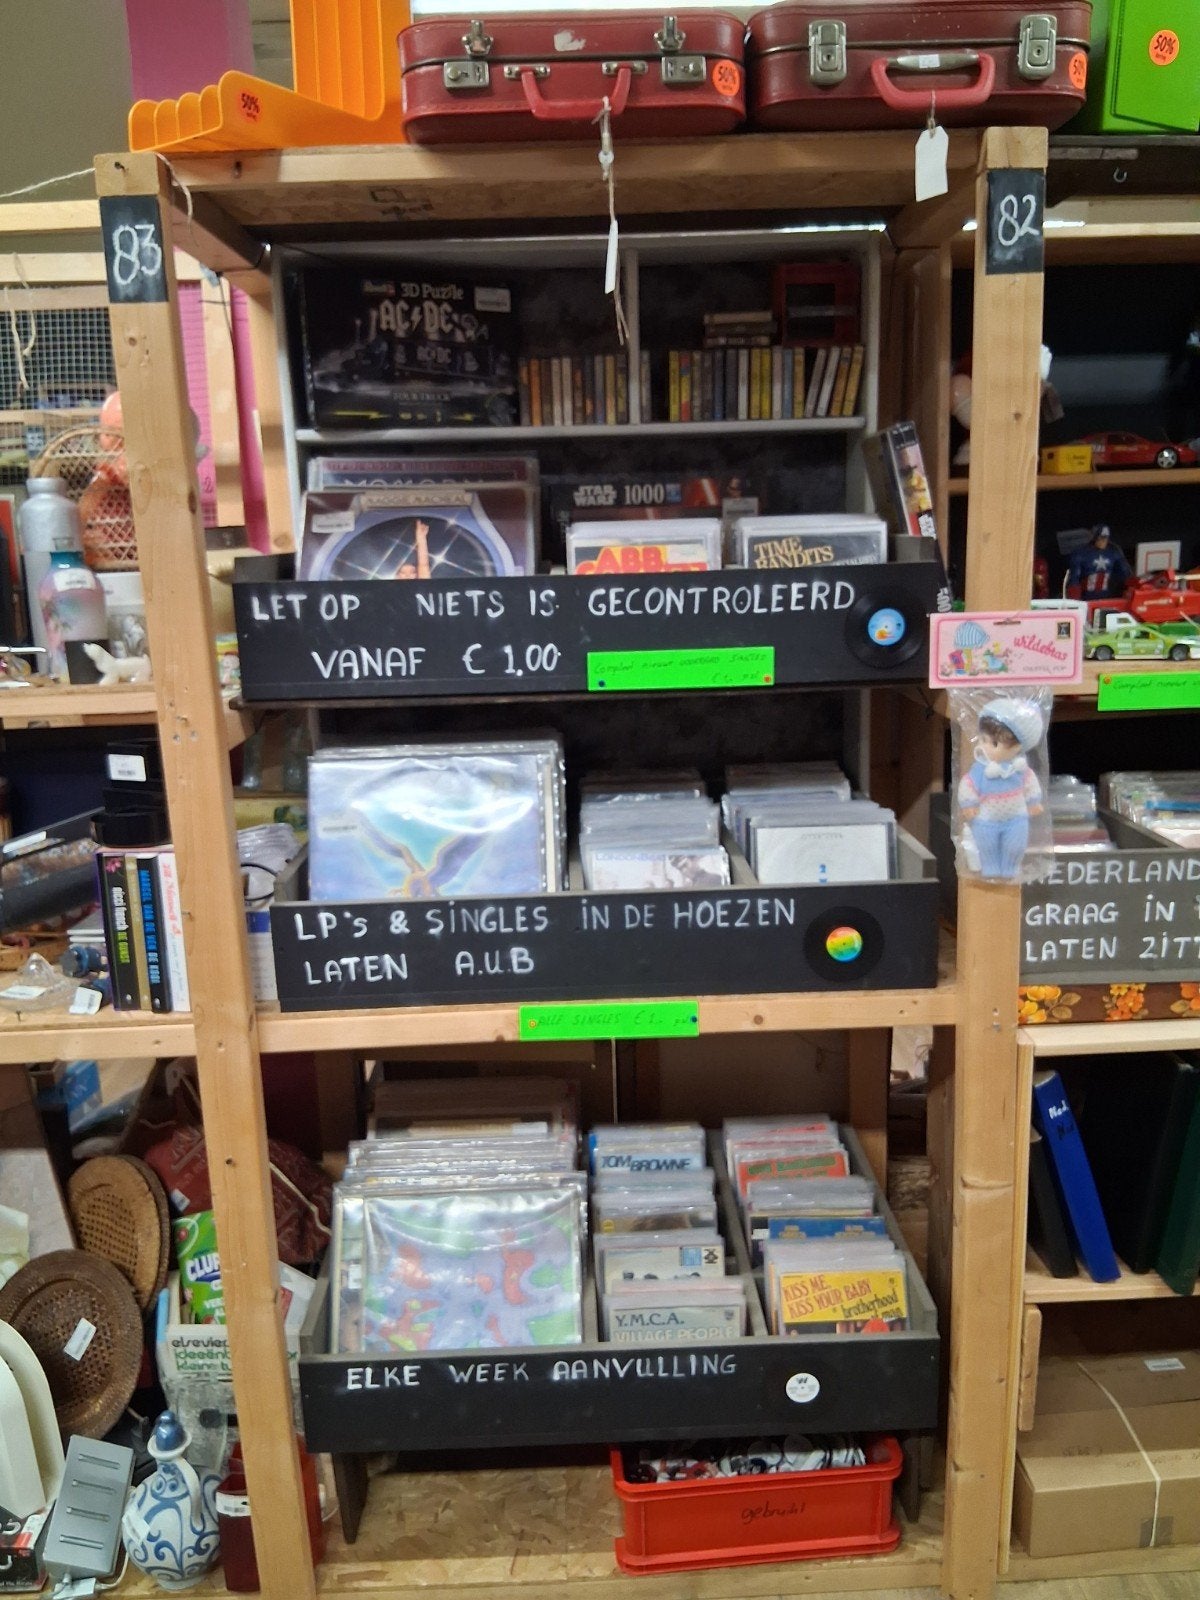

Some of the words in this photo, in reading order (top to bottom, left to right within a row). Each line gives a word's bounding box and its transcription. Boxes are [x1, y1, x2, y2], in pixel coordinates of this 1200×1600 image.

[1154, 34, 1176, 55] 50%
[998, 194, 1040, 246] 82
[112, 223, 163, 285] 83
[624, 483, 665, 505] 1000
[754, 537, 802, 559] TIME
[252, 594, 307, 621] LET
[319, 593, 360, 621] OP
[416, 590, 505, 618] NIETS
[529, 589, 557, 617] IS
[588, 580, 856, 617] GECONTROLEERD
[310, 646, 426, 680] VANAF
[462, 643, 486, 674] €
[503, 643, 560, 677] 1.00
[1026, 857, 1200, 886] EDERLAND
[294, 911, 368, 941] LP's
[389, 910, 410, 935] &
[624, 904, 656, 930] DE
[674, 898, 796, 930] HOEZEN
[1025, 901, 1120, 926] GRAAG
[1025, 936, 1118, 962] LATEN
[304, 953, 409, 985] LATEN
[601, 1155, 632, 1168] TOM
[630, 1158, 692, 1171] BROWNE
[782, 1281, 809, 1302] KISS
[615, 1312, 685, 1327] Y.M.C.A.
[787, 1298, 814, 1319] KISS
[614, 1328, 673, 1342] VILLAGE
[678, 1326, 735, 1340] PEOPLE
[346, 1365, 421, 1390] ELKE
[448, 1362, 530, 1384] WEEK
[552, 1354, 738, 1382] AANVULLING
